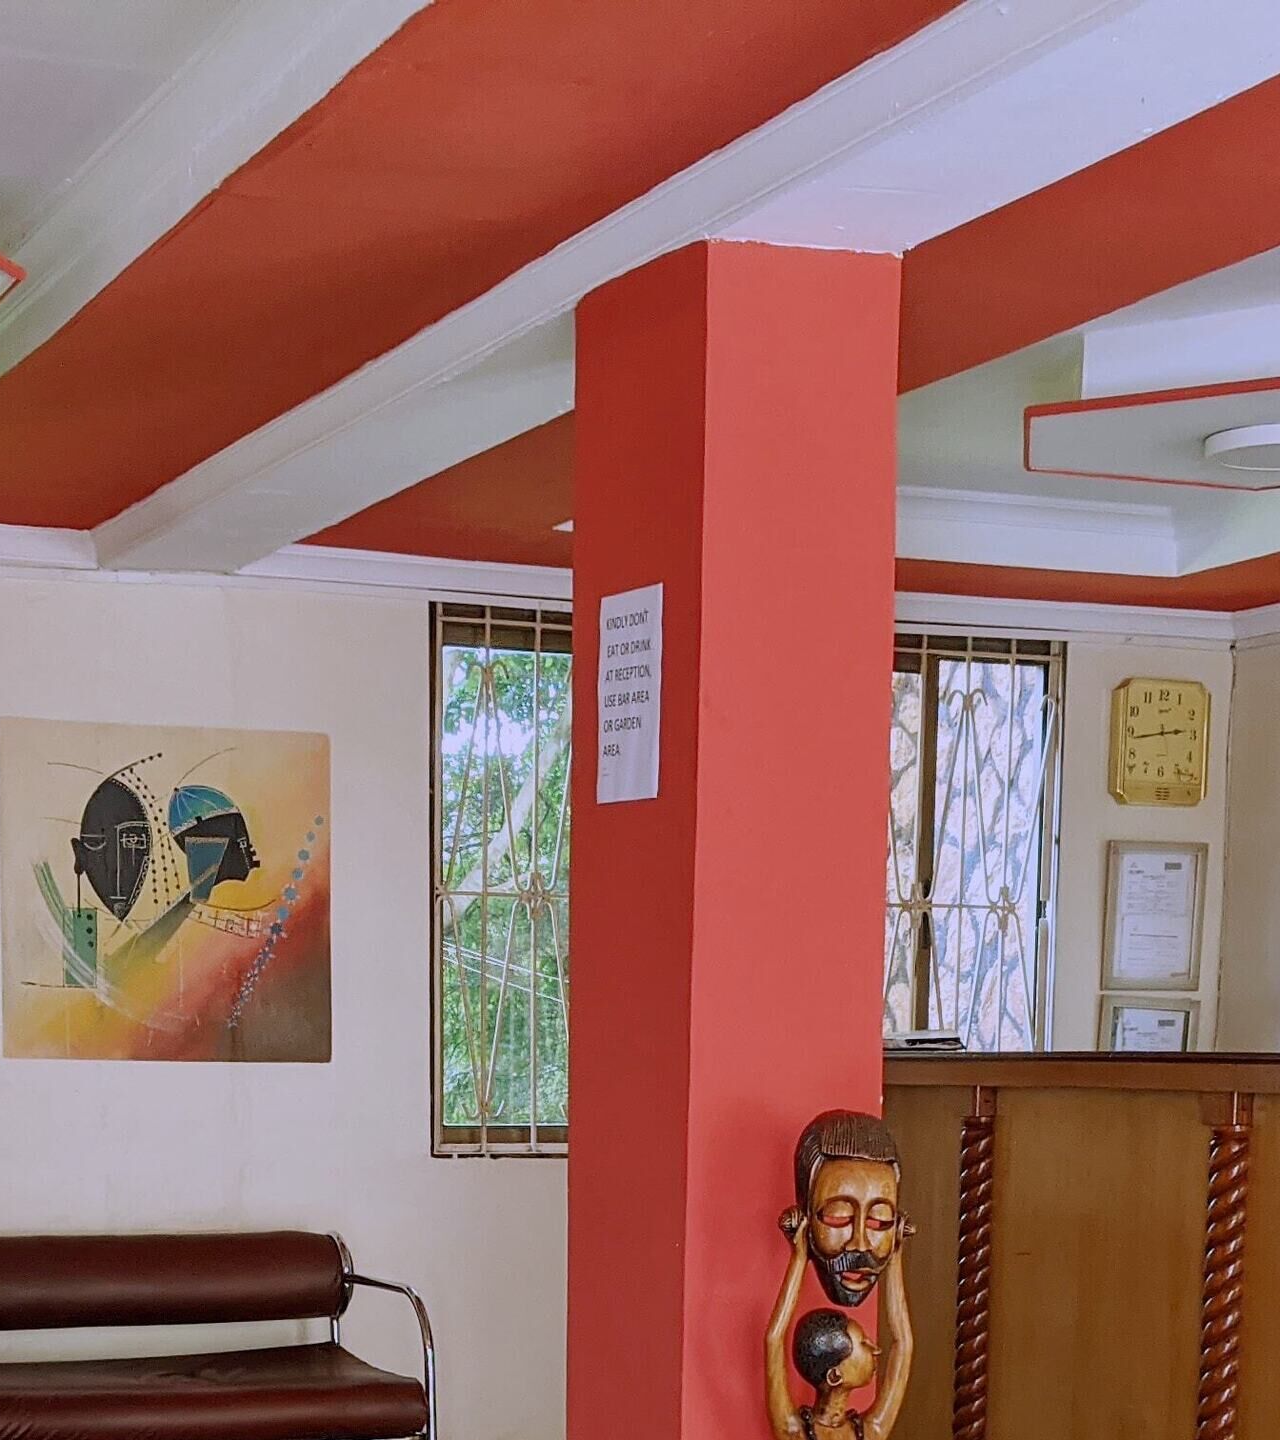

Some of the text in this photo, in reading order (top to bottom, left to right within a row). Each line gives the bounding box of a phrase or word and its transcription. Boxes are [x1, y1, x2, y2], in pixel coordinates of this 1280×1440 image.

[606, 615, 628, 630] KINDLY
[607, 637, 651, 658] EAT OR DRINK
[605, 669, 613, 681] AT
[604, 690, 650, 708] USE BAR AREA
[1159, 689, 1170, 701] 12
[603, 716, 642, 733] OR GARDEN
[603, 743, 620, 757] AREA
